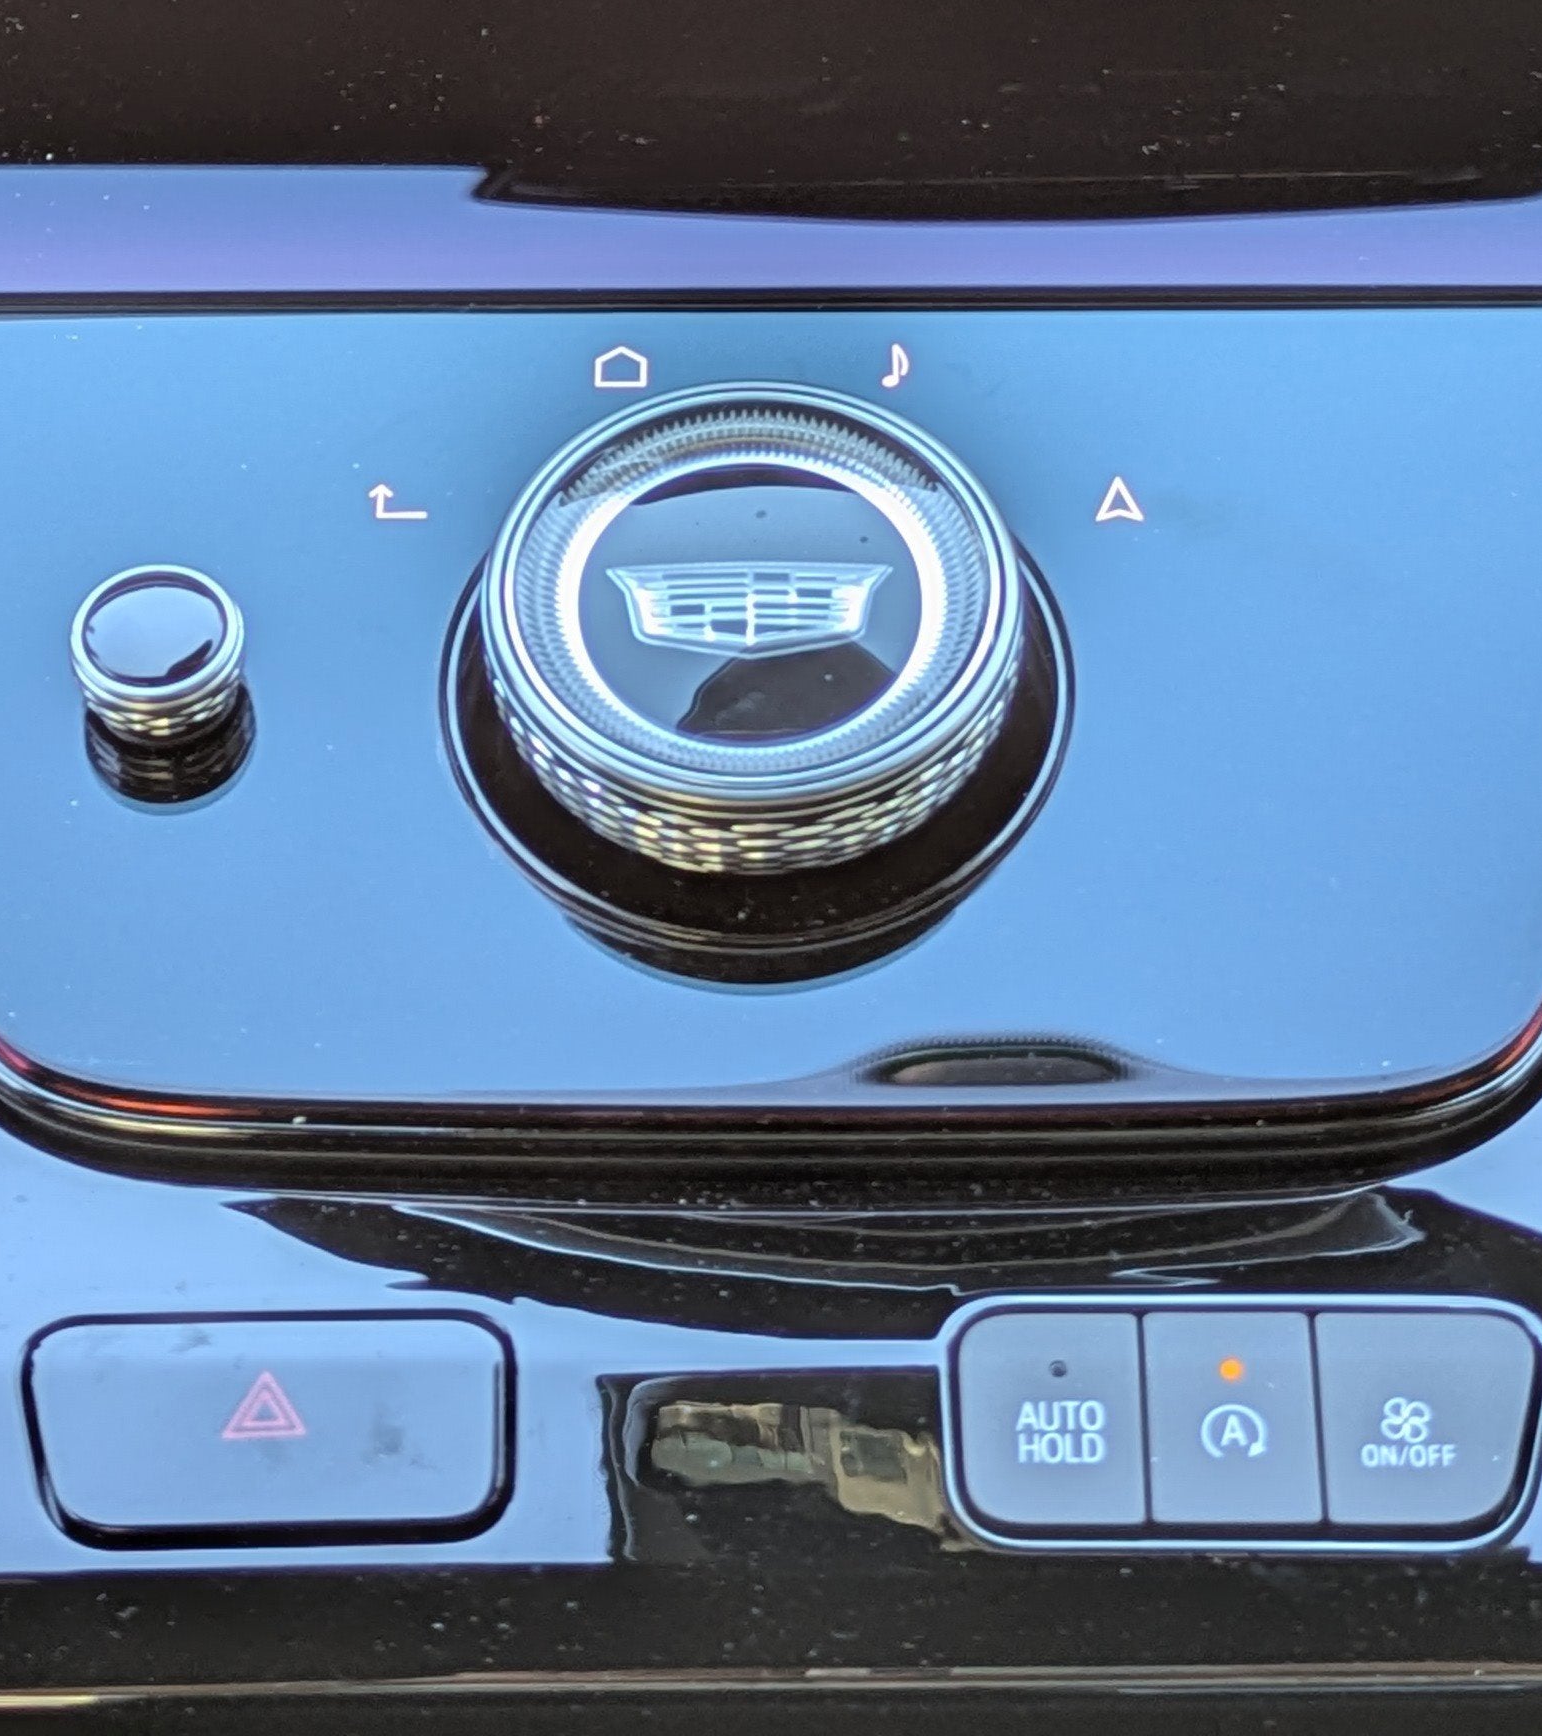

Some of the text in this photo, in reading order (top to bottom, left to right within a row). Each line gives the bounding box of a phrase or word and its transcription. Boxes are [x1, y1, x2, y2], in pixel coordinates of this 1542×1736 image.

[1015, 1399, 1107, 1432] AUTO
[1017, 1432, 1107, 1464] HOLD
[1360, 1443, 1457, 1468] ON/OFF
